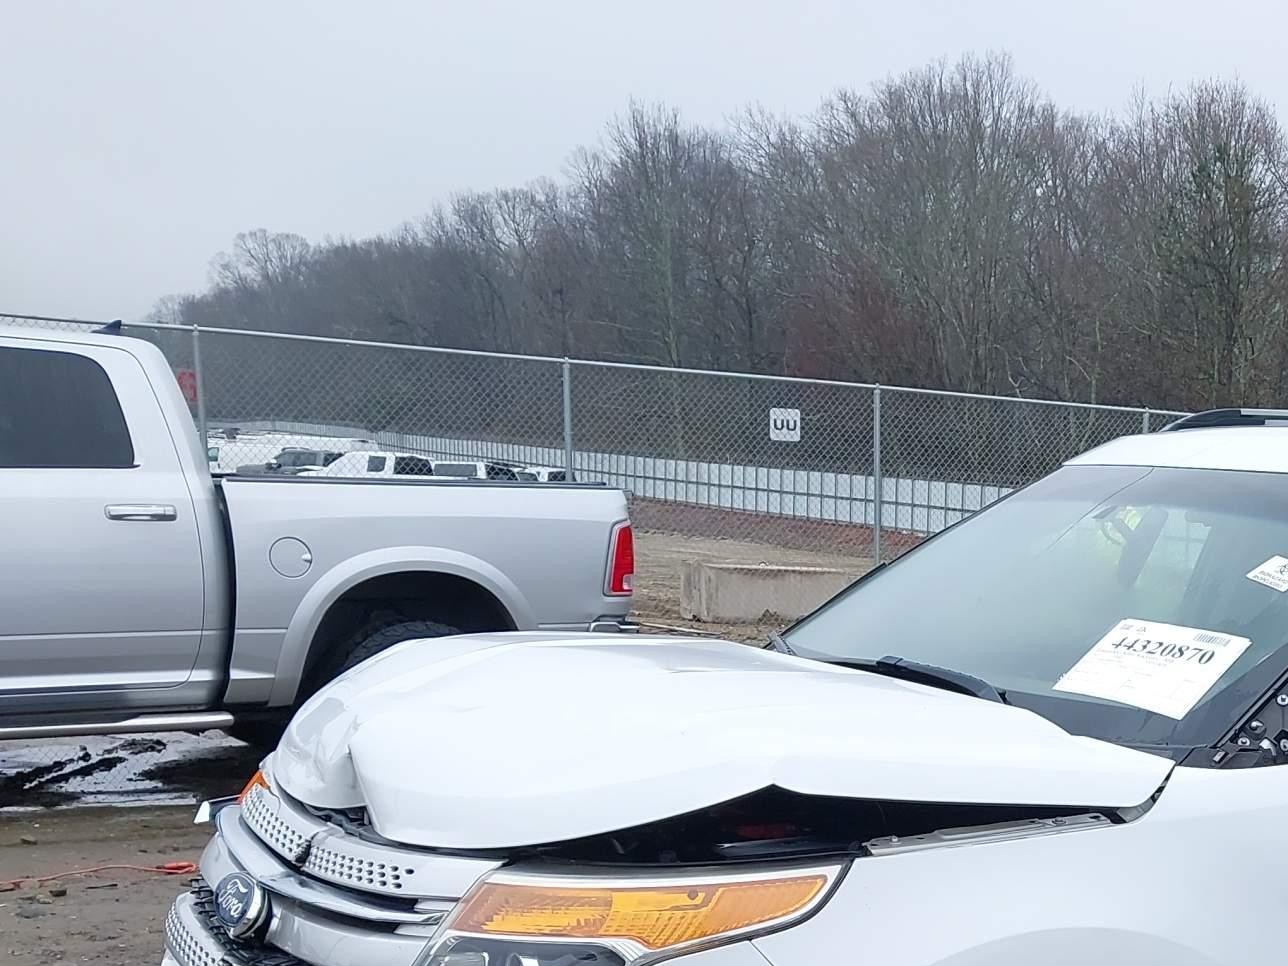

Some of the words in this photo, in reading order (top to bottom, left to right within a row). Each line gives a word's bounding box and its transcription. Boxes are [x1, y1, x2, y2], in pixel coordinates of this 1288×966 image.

[773, 418, 797, 432] UU
[1112, 636, 1216, 665] 44320870
[218, 879, 248, 918] Ford
